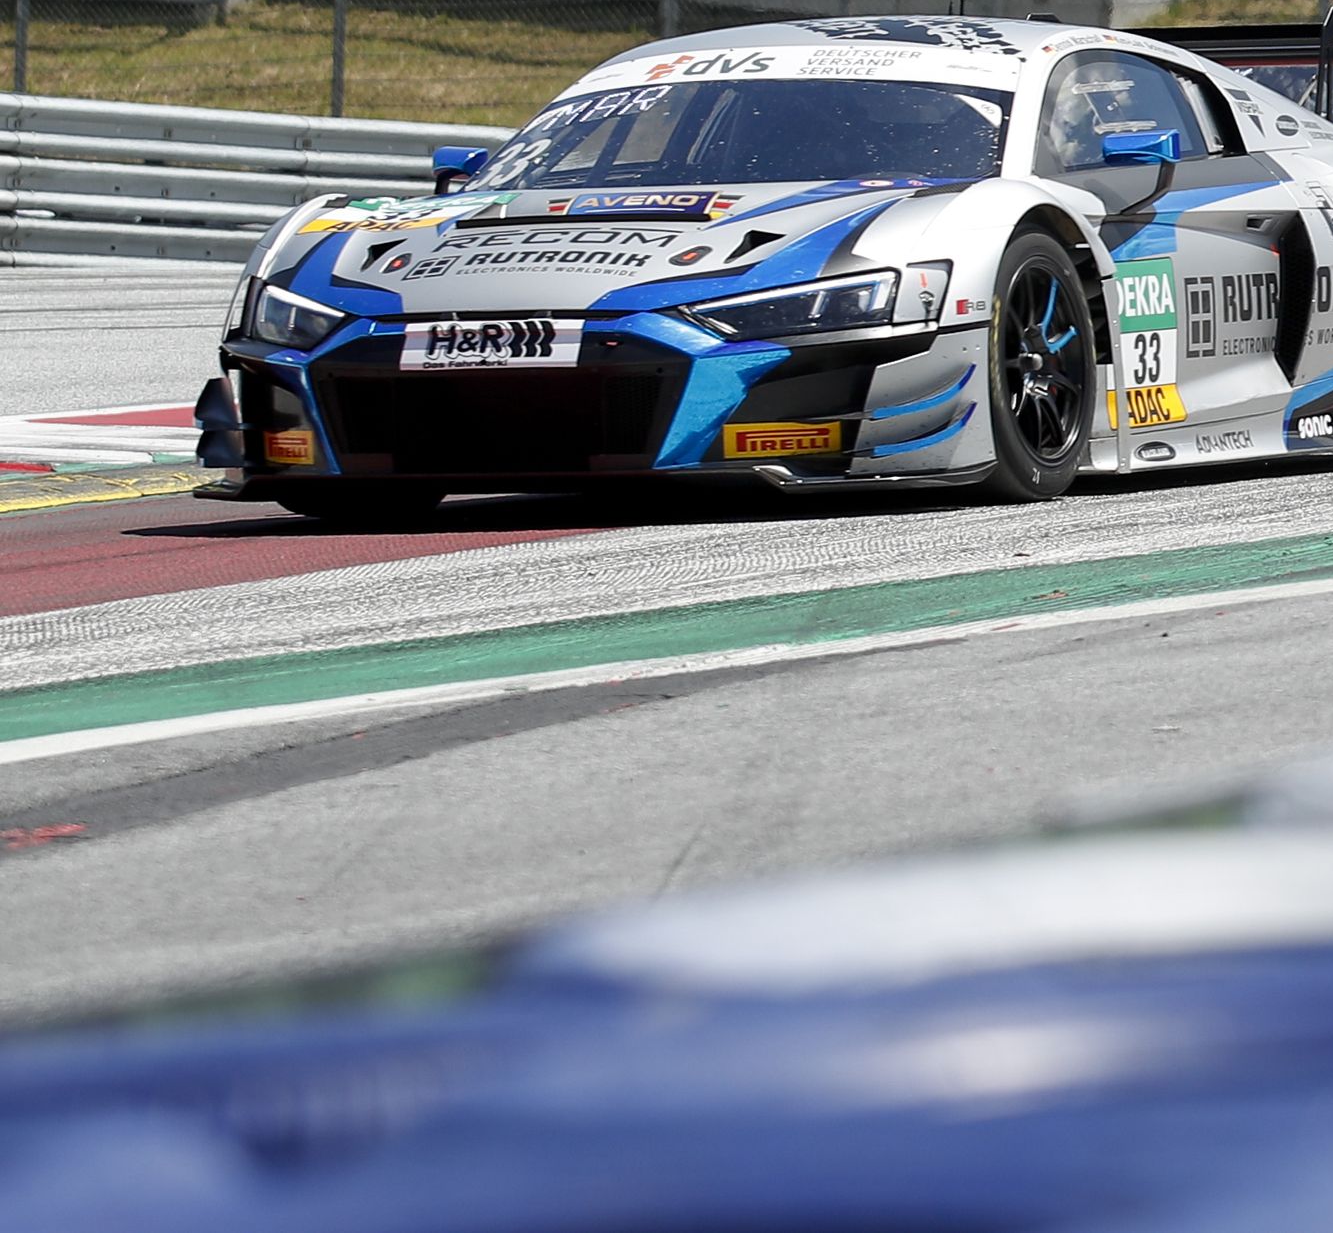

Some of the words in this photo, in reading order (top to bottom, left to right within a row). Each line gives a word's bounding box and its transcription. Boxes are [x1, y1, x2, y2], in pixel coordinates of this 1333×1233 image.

[682, 53, 776, 77] dvs
[806, 58, 895, 67] VERSAND
[812, 49, 922, 59] DEUTSCHER
[796, 67, 878, 76] SERVICE
[574, 194, 704, 208] AVENO
[432, 229, 680, 253] RECOM
[465, 250, 652, 267] RUTRONIK
[456, 266, 549, 275] ELECTRONICS
[555, 266, 639, 278] WORLDWIDE
[427, 323, 509, 358] H&R
[1133, 332, 1161, 385] 33
[265, 432, 308, 460] PIRELLI
[736, 428, 831, 454] PIRELLI
[1195, 430, 1254, 454] ADVANTECH
